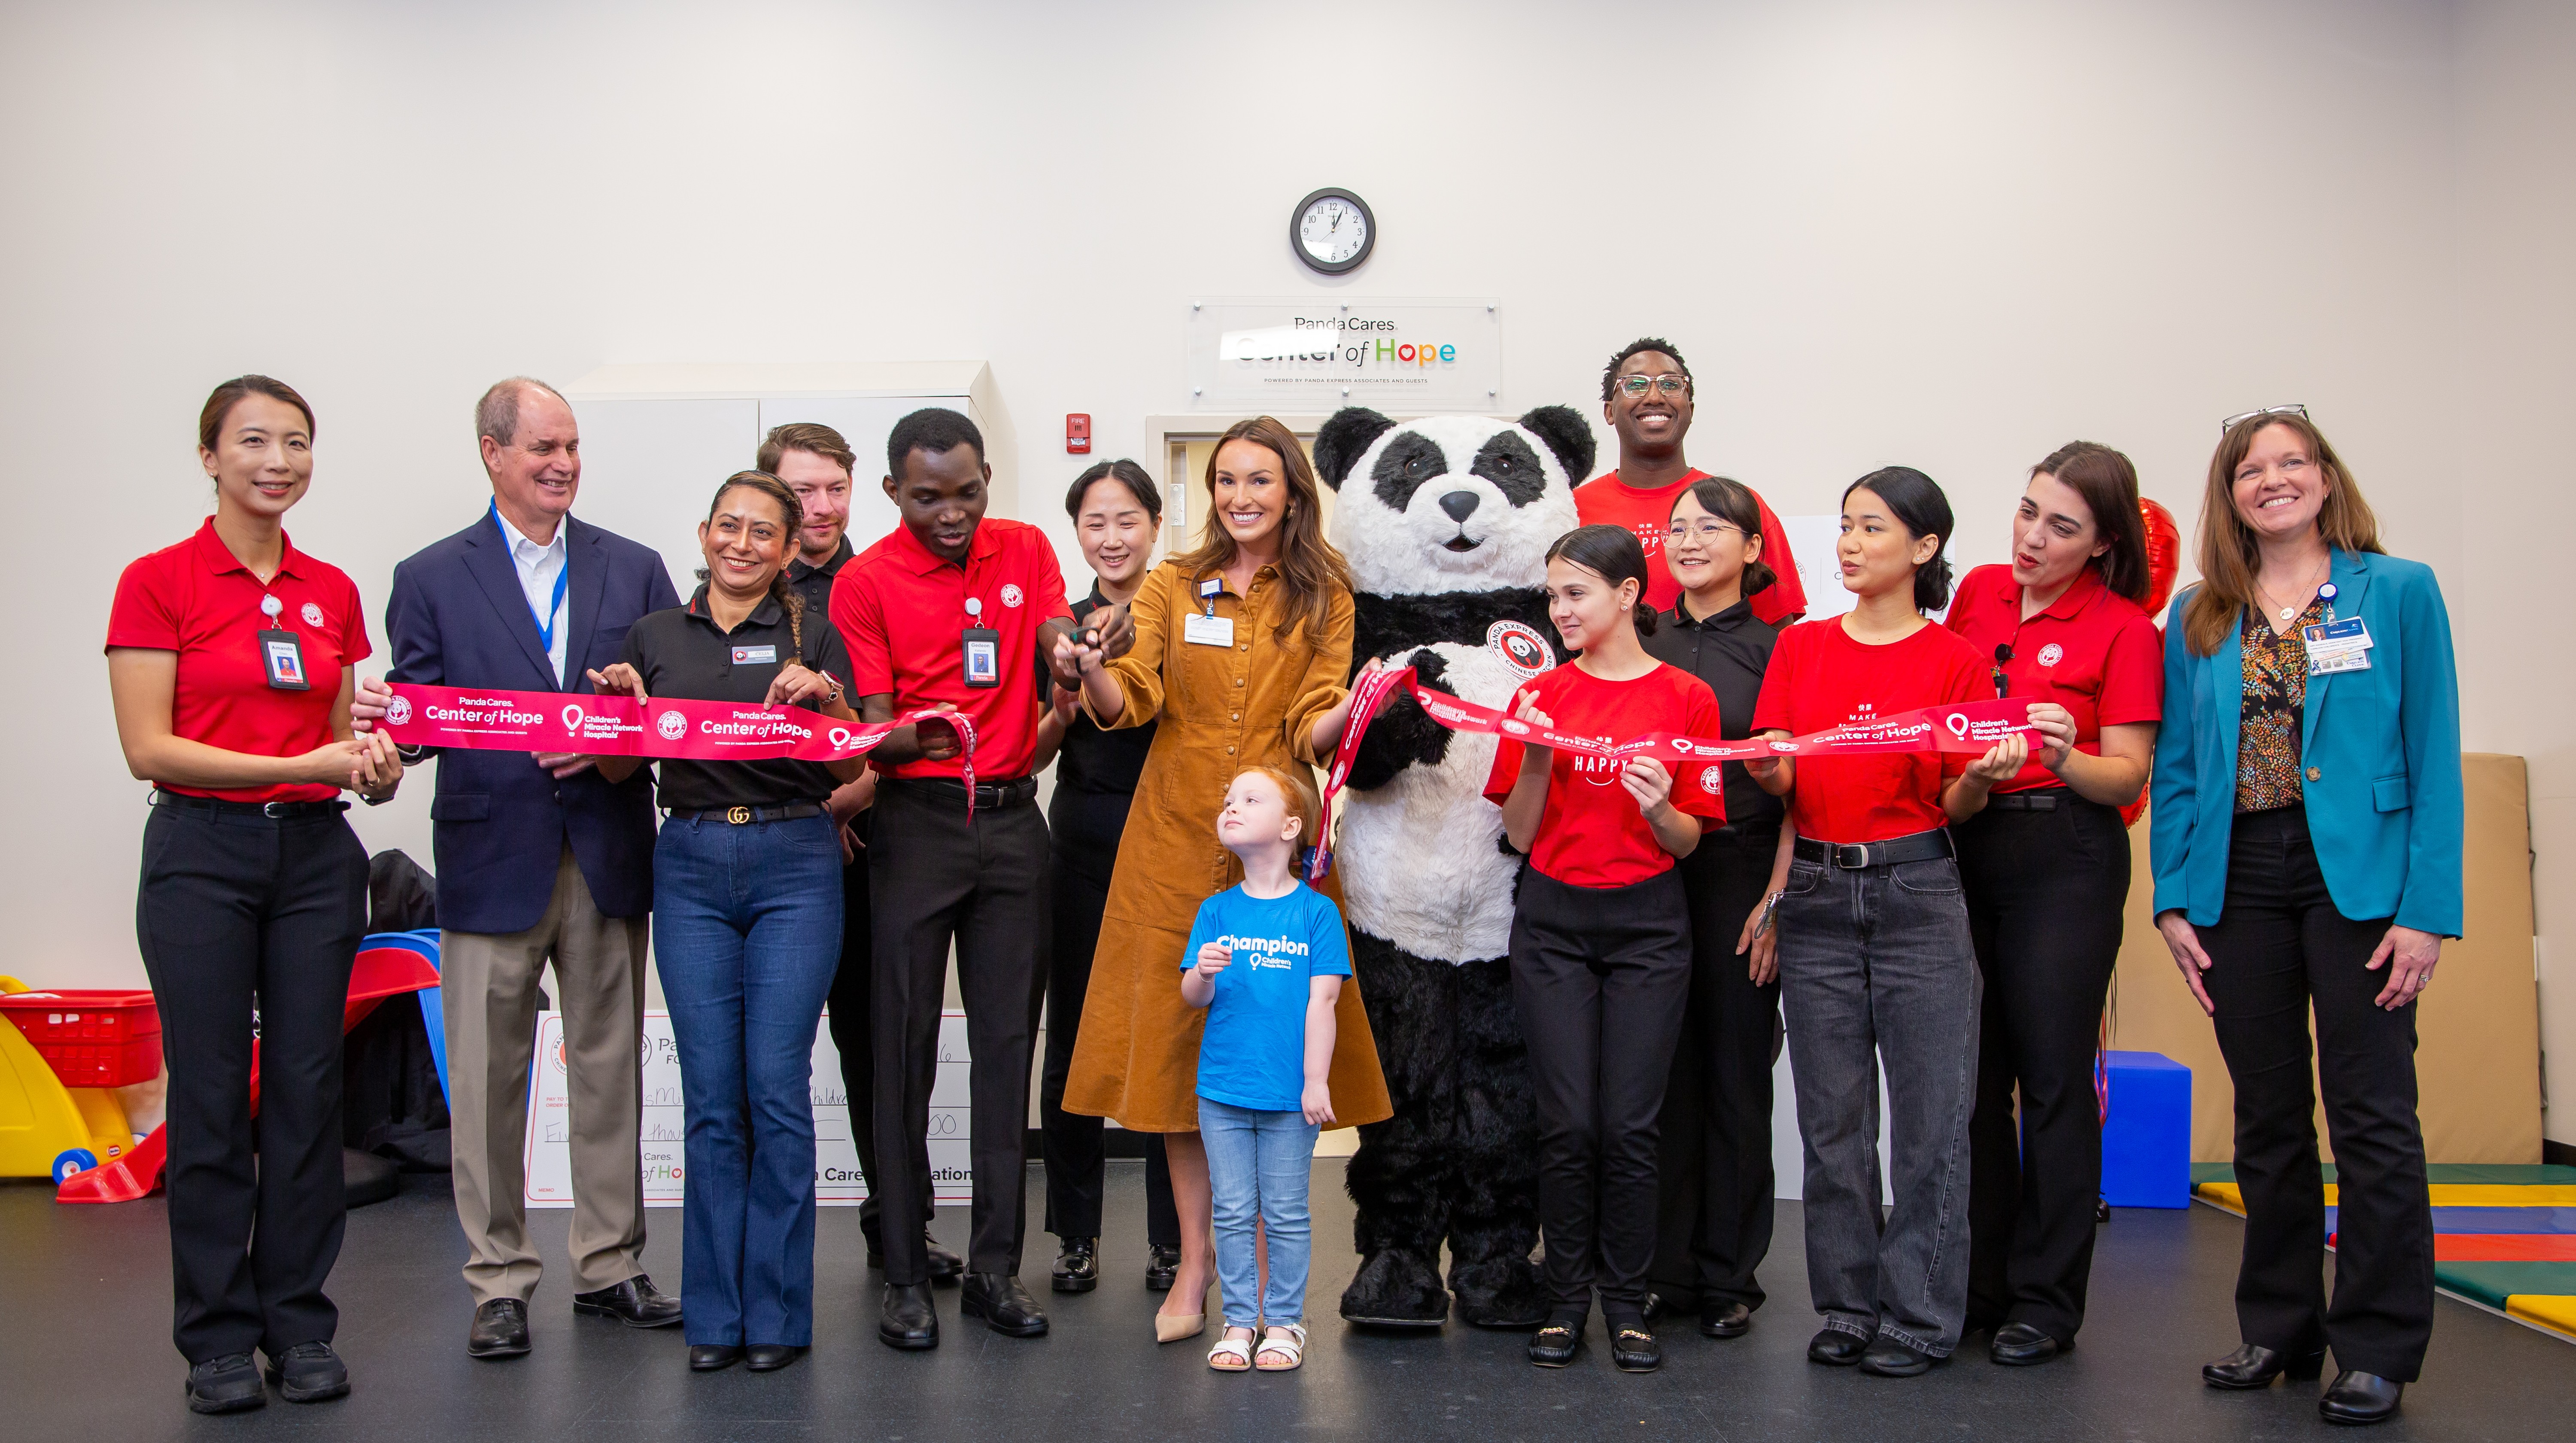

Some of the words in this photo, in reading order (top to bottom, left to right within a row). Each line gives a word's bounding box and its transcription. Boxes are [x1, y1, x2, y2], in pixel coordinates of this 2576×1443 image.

[1308, 215, 1316, 223] 10
[1331, 253, 1336, 261] 6
[1294, 317, 1346, 330] Panda
[1236, 338, 1341, 361] Cer
[1346, 341, 1370, 367] of
[1376, 339, 1456, 366] Hope
[1492, 626, 1504, 649] PANDA
[1504, 623, 1544, 644] EXPRESS
[1506, 660, 1537, 676] CHINESE
[459, 697, 486, 706] Panda
[426, 705, 483, 722] Center
[484, 711, 497, 725] of
[500, 710, 544, 726] Hope
[732, 711, 760, 720] Panda
[1345, 696, 1367, 750] Center
[1970, 719, 2008, 728] Children's
[701, 720, 756, 735] Center
[757, 724, 771, 738] of
[772, 722, 812, 738] Hope
[1813, 732, 1869, 743] Center
[1871, 731, 1884, 740] of
[1886, 723, 1932, 738] Hope
[1842, 724, 1870, 732] Panda
[2001, 723, 2033, 732] Network
[1543, 732, 1598, 748] Center
[1574, 756, 1628, 773] HAPPY
[1702, 769, 1712, 781] PANDA
[1216, 934, 1309, 956] Champion
[1262, 957, 1291, 966] Children's
[642, 1167, 656, 1182] of
[658, 1165, 684, 1179] Ho
